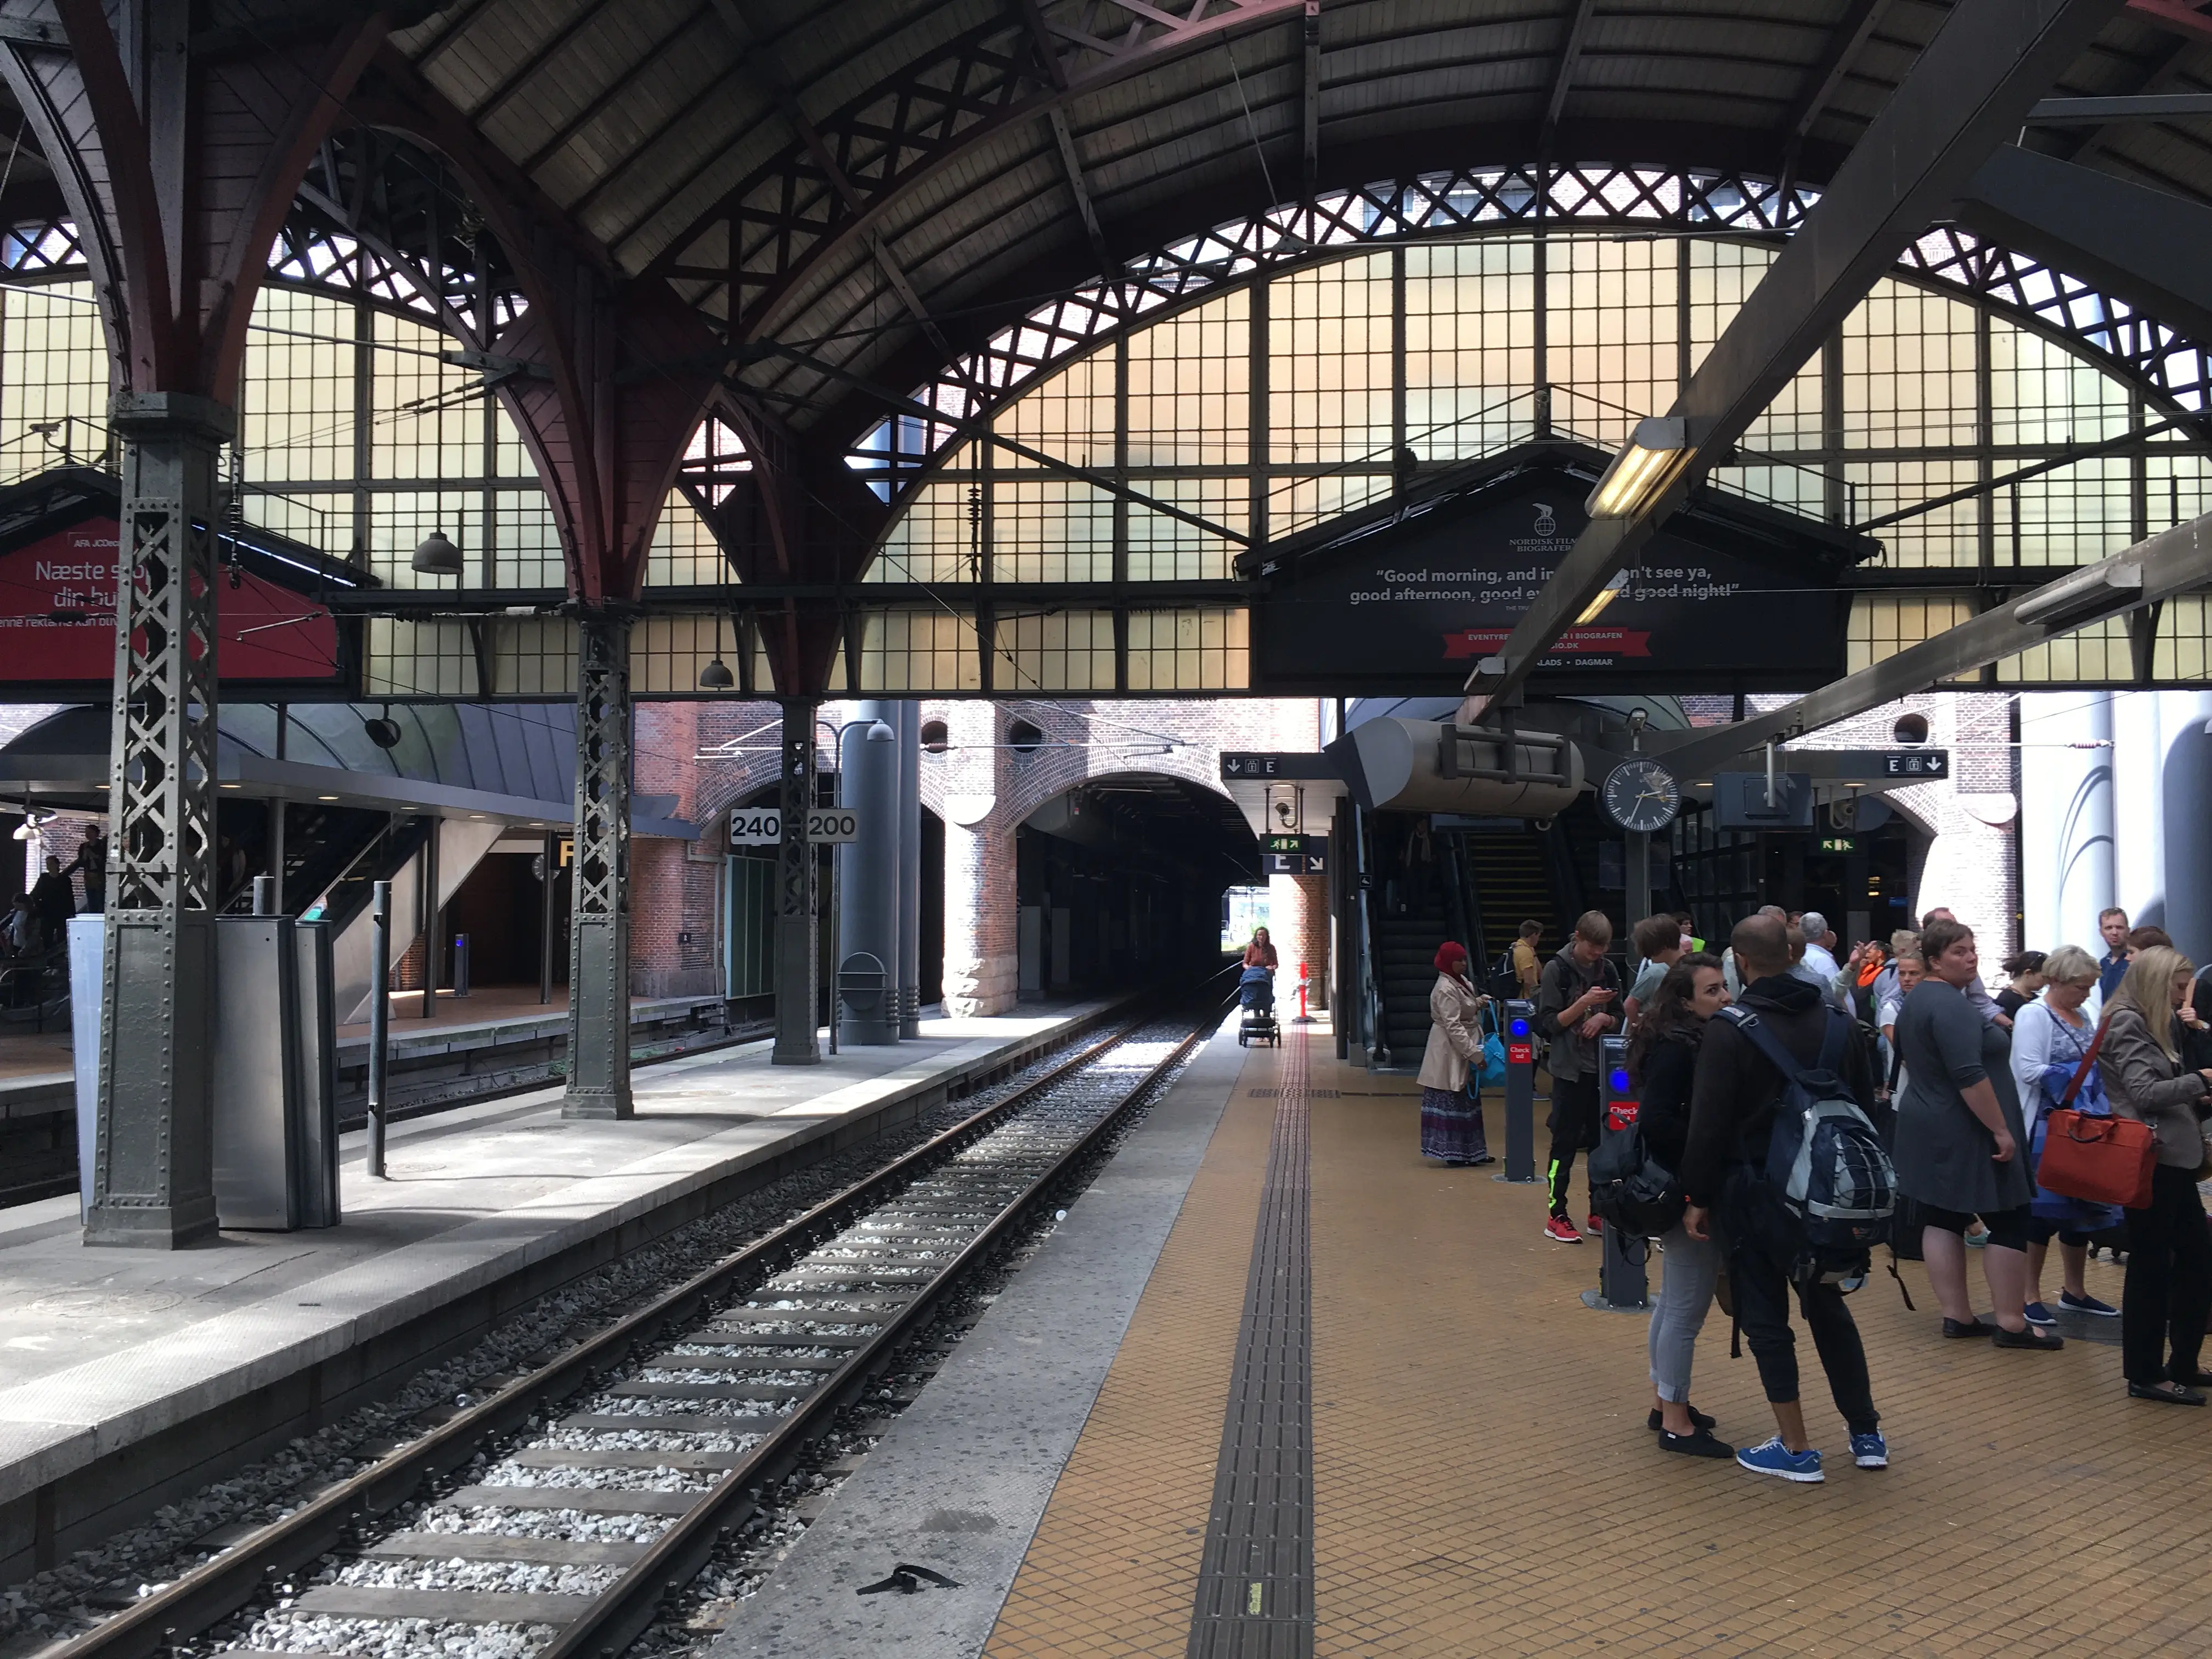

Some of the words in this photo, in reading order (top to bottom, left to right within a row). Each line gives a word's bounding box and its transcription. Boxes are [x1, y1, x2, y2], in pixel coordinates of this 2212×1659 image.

[35, 561, 104, 580] Næste
[1431, 568, 1502, 584] morning,
[1506, 567, 1536, 581] and
[1656, 568, 1684, 579] see
[1688, 568, 1712, 582] ya,
[55, 586, 84, 607] din
[1350, 588, 1390, 605] good
[1395, 588, 1475, 603] afternoon,
[1481, 586, 1522, 603] good
[1635, 584, 1678, 601] good
[1267, 761, 1274, 772] E
[1889, 760, 1899, 771] E
[732, 816, 779, 837] 240
[809, 816, 855, 835] 200
